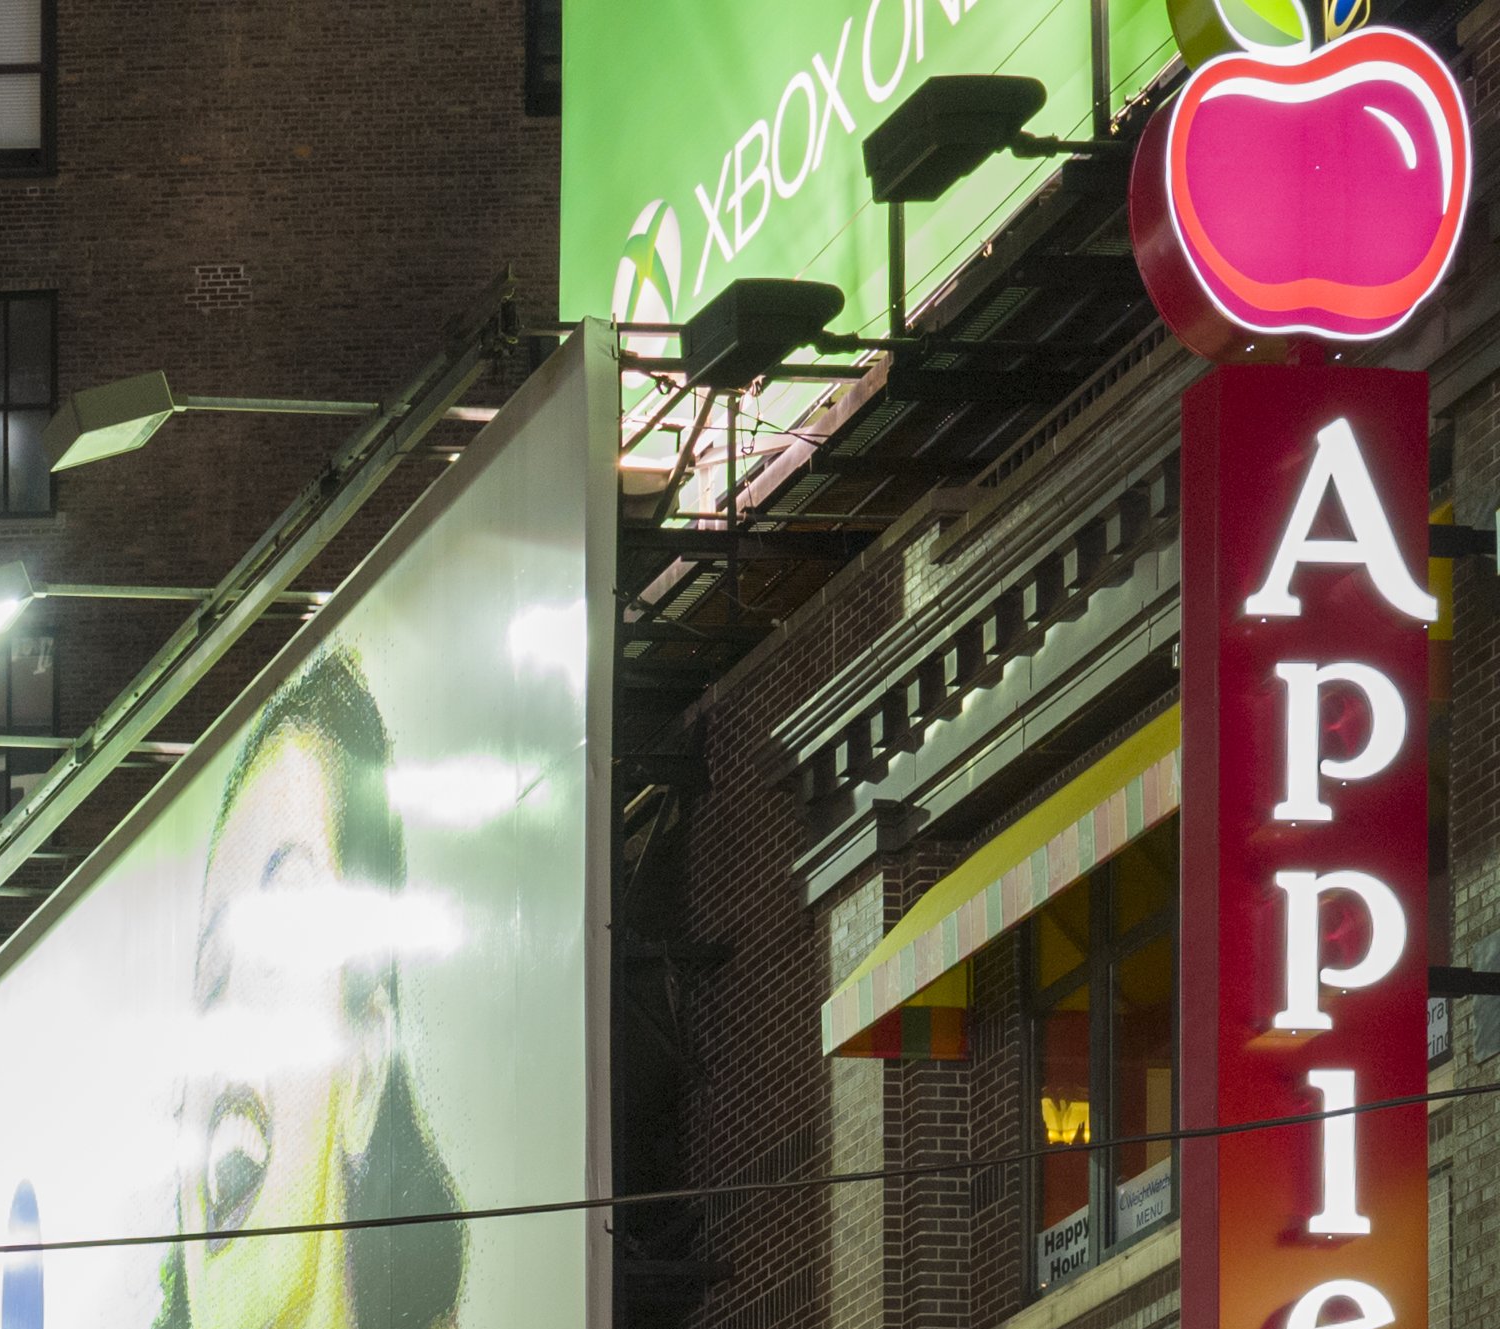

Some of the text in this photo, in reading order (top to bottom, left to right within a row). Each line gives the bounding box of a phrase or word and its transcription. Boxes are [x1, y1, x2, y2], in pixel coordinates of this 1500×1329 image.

[693, 16, 856, 297] XBOX
[1043, 1212, 1089, 1284] Happy Hour
